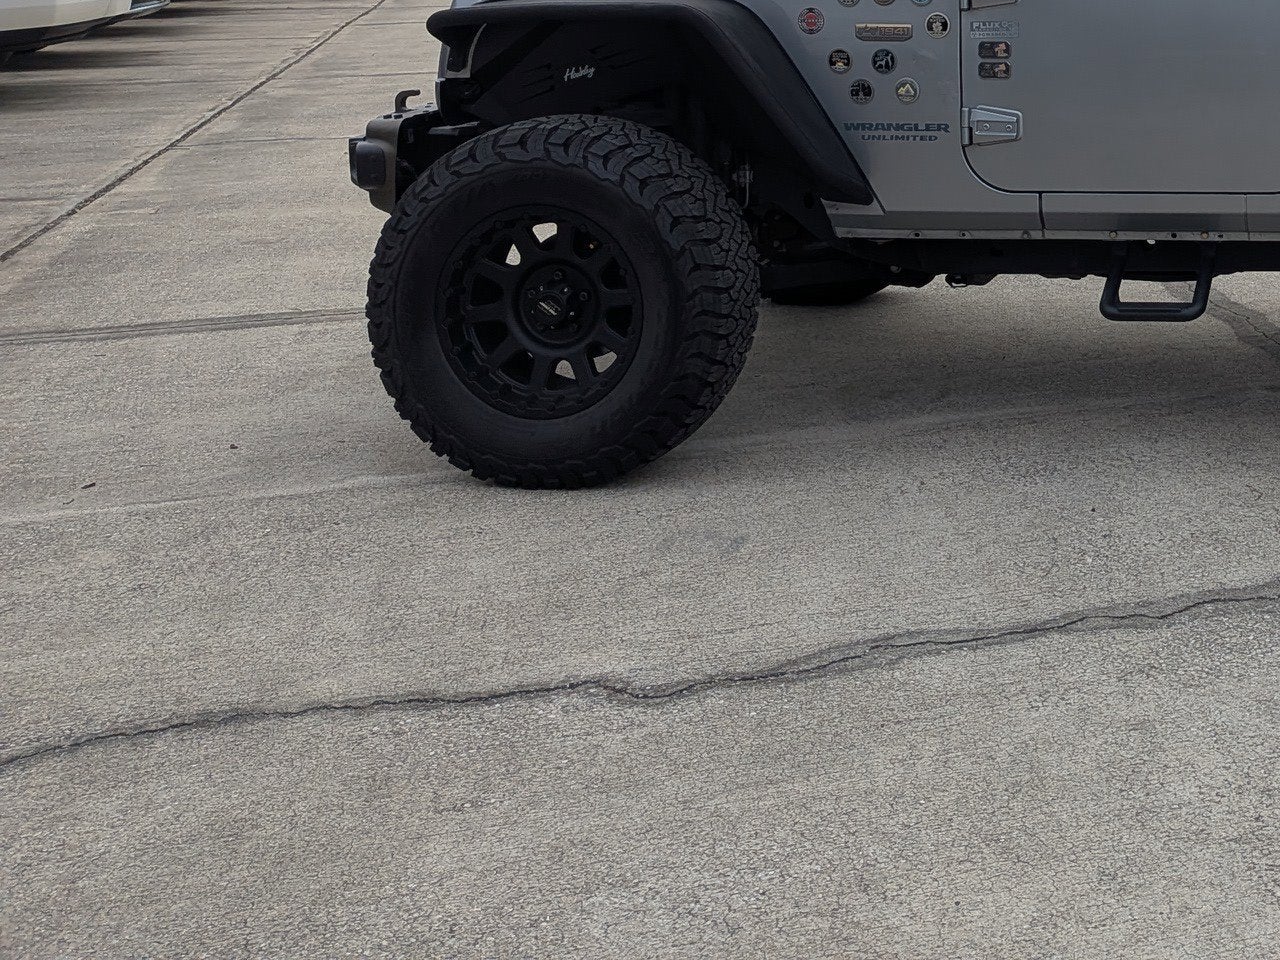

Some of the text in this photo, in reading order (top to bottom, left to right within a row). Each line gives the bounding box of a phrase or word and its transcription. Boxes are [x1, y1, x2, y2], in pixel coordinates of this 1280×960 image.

[880, 26, 908, 36] 1941
[843, 122, 950, 134] WRANGLER
[861, 134, 938, 142] UNLIMITED
